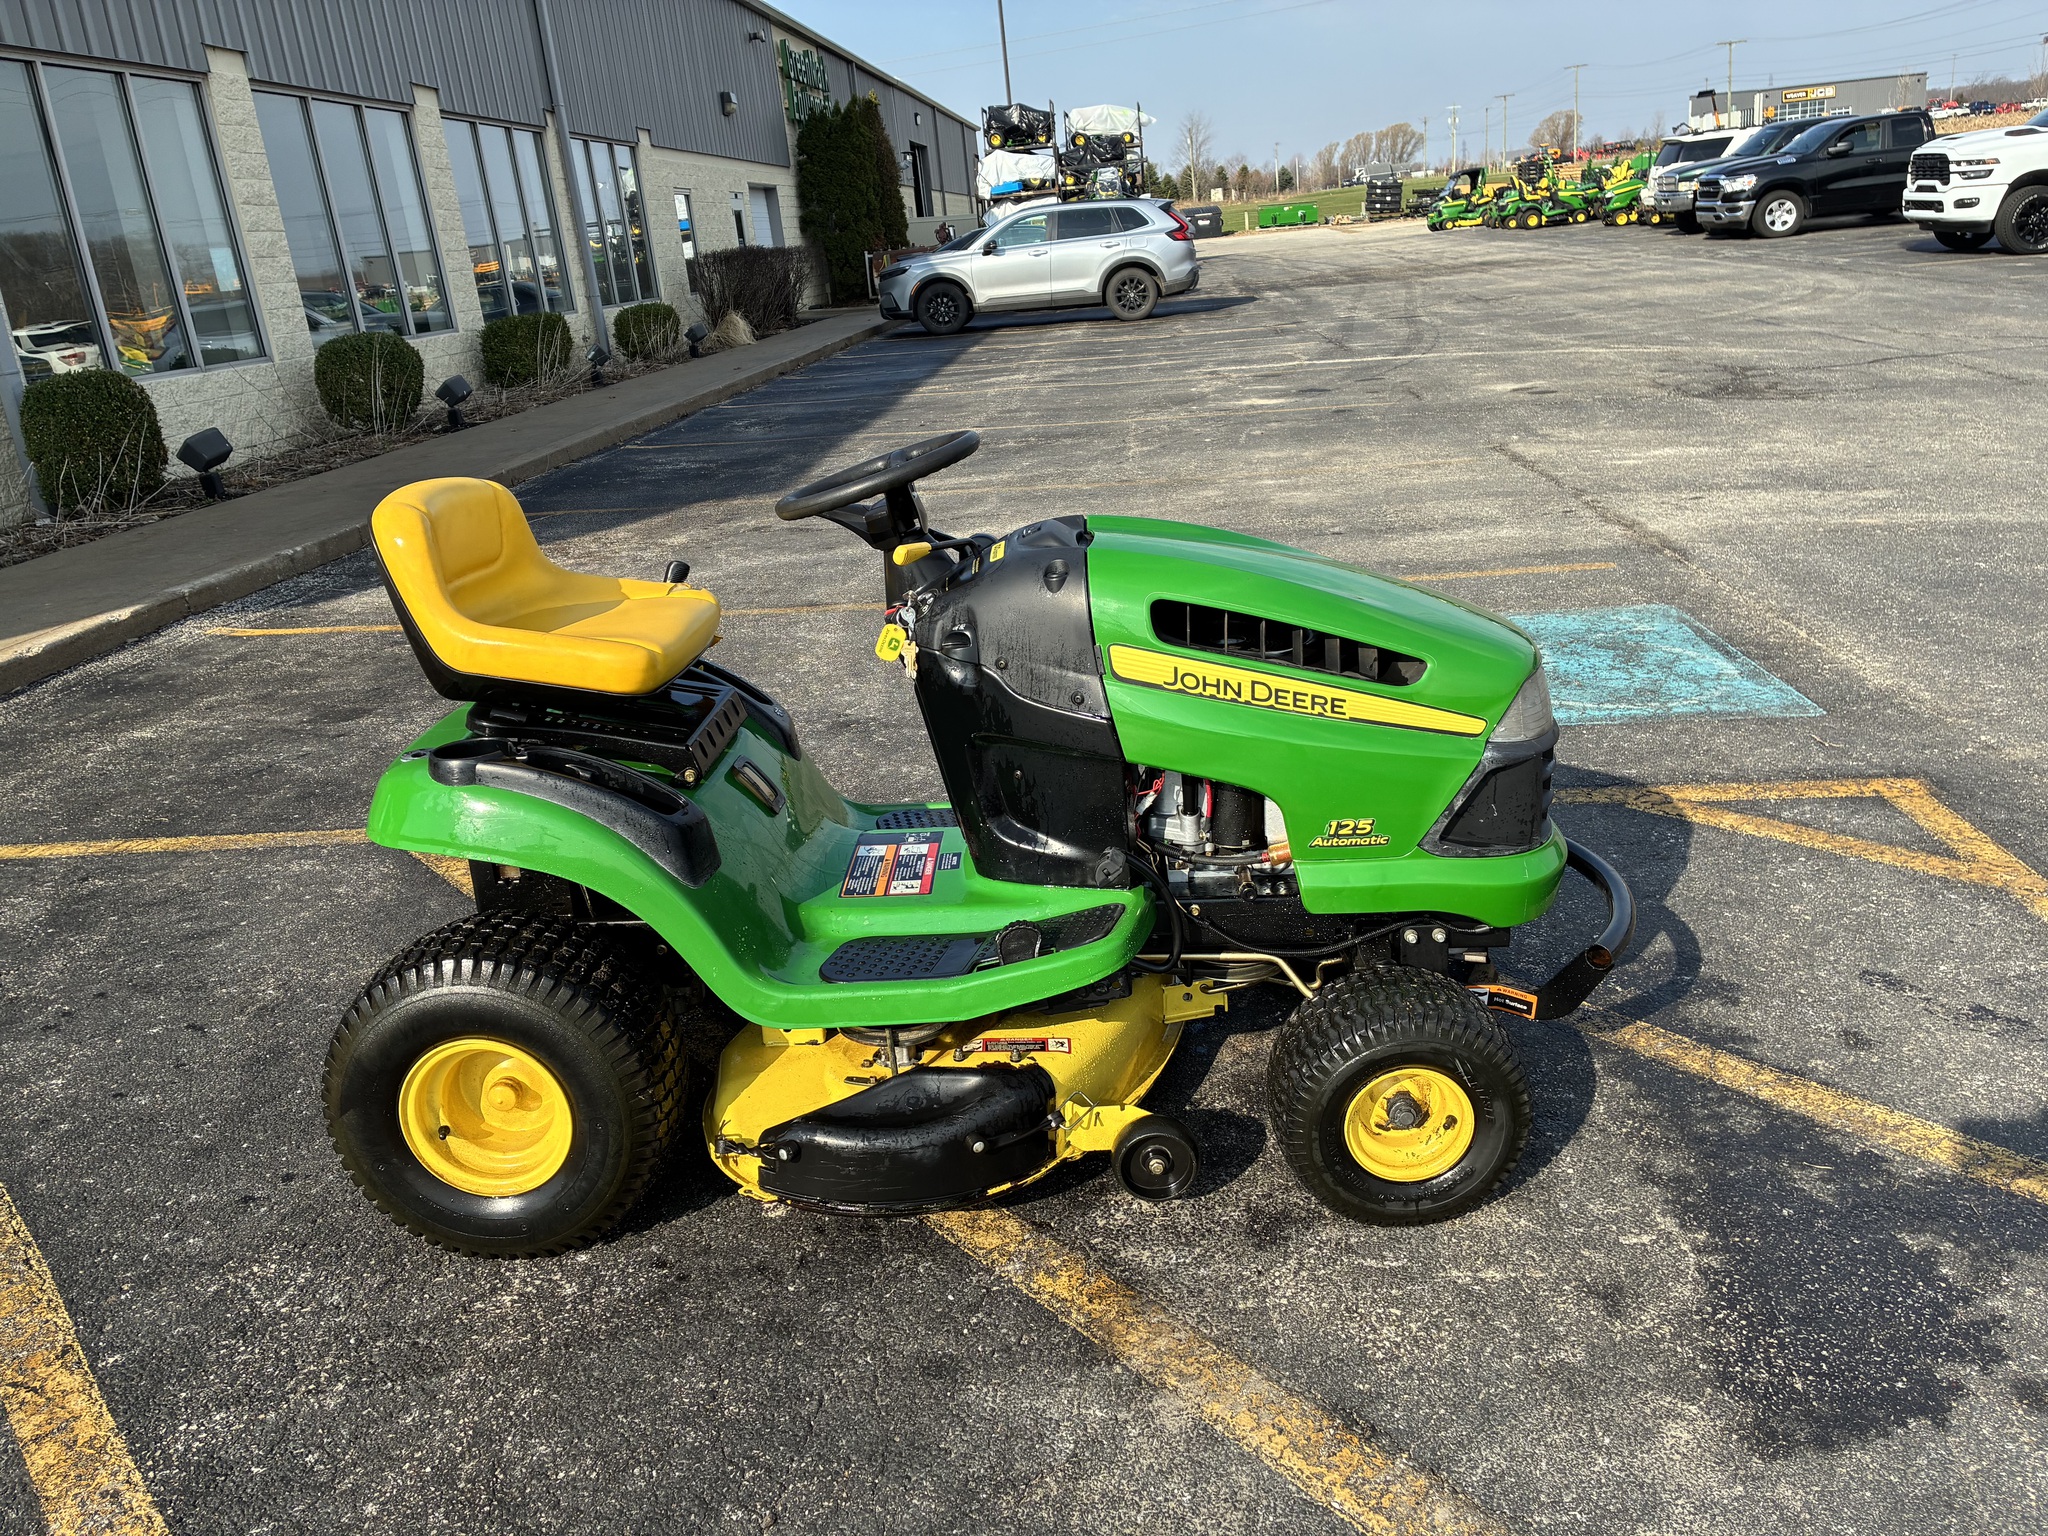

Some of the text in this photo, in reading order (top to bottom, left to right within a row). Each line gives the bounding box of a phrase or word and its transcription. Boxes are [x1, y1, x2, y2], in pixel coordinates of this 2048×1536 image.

[1785, 91, 1807, 99] WEAVER
[1163, 666, 1347, 716] JOHN DEERE
[1328, 818, 1375, 837] 125
[1309, 834, 1390, 848] Automatic
[1503, 988, 1528, 999] WARNING
[1505, 999, 1528, 1010] Surface
